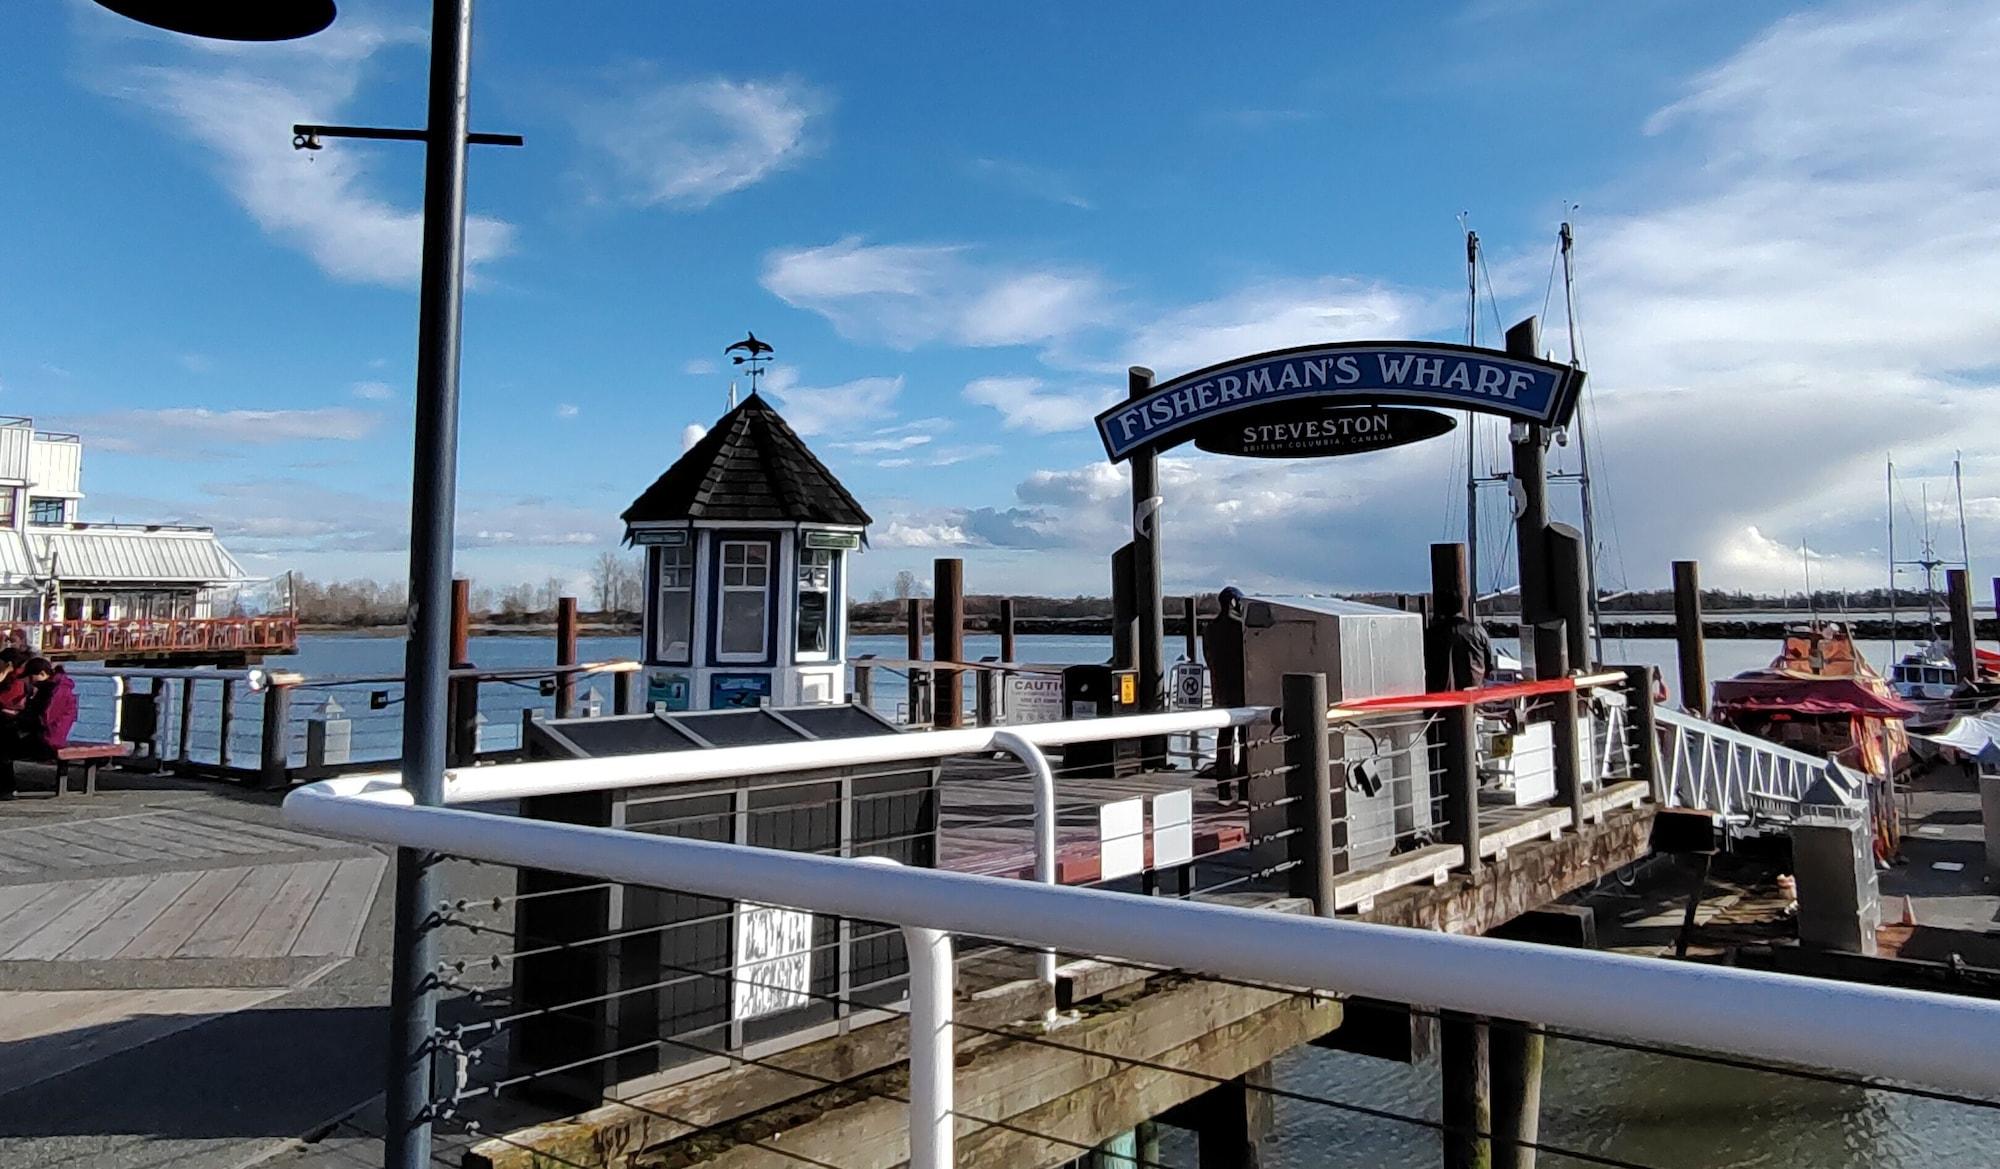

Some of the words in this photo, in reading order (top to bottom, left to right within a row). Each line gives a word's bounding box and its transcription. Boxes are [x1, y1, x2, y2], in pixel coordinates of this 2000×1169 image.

[1118, 356, 1360, 441] FISHERMAN'S
[1378, 353, 1536, 400] WHARF
[1243, 413, 1389, 443] STEVESTON
[1243, 443, 1283, 453] BRITISH
[1288, 438, 1344, 449] COLUMBIA,
[1351, 433, 1393, 444] CANADA
